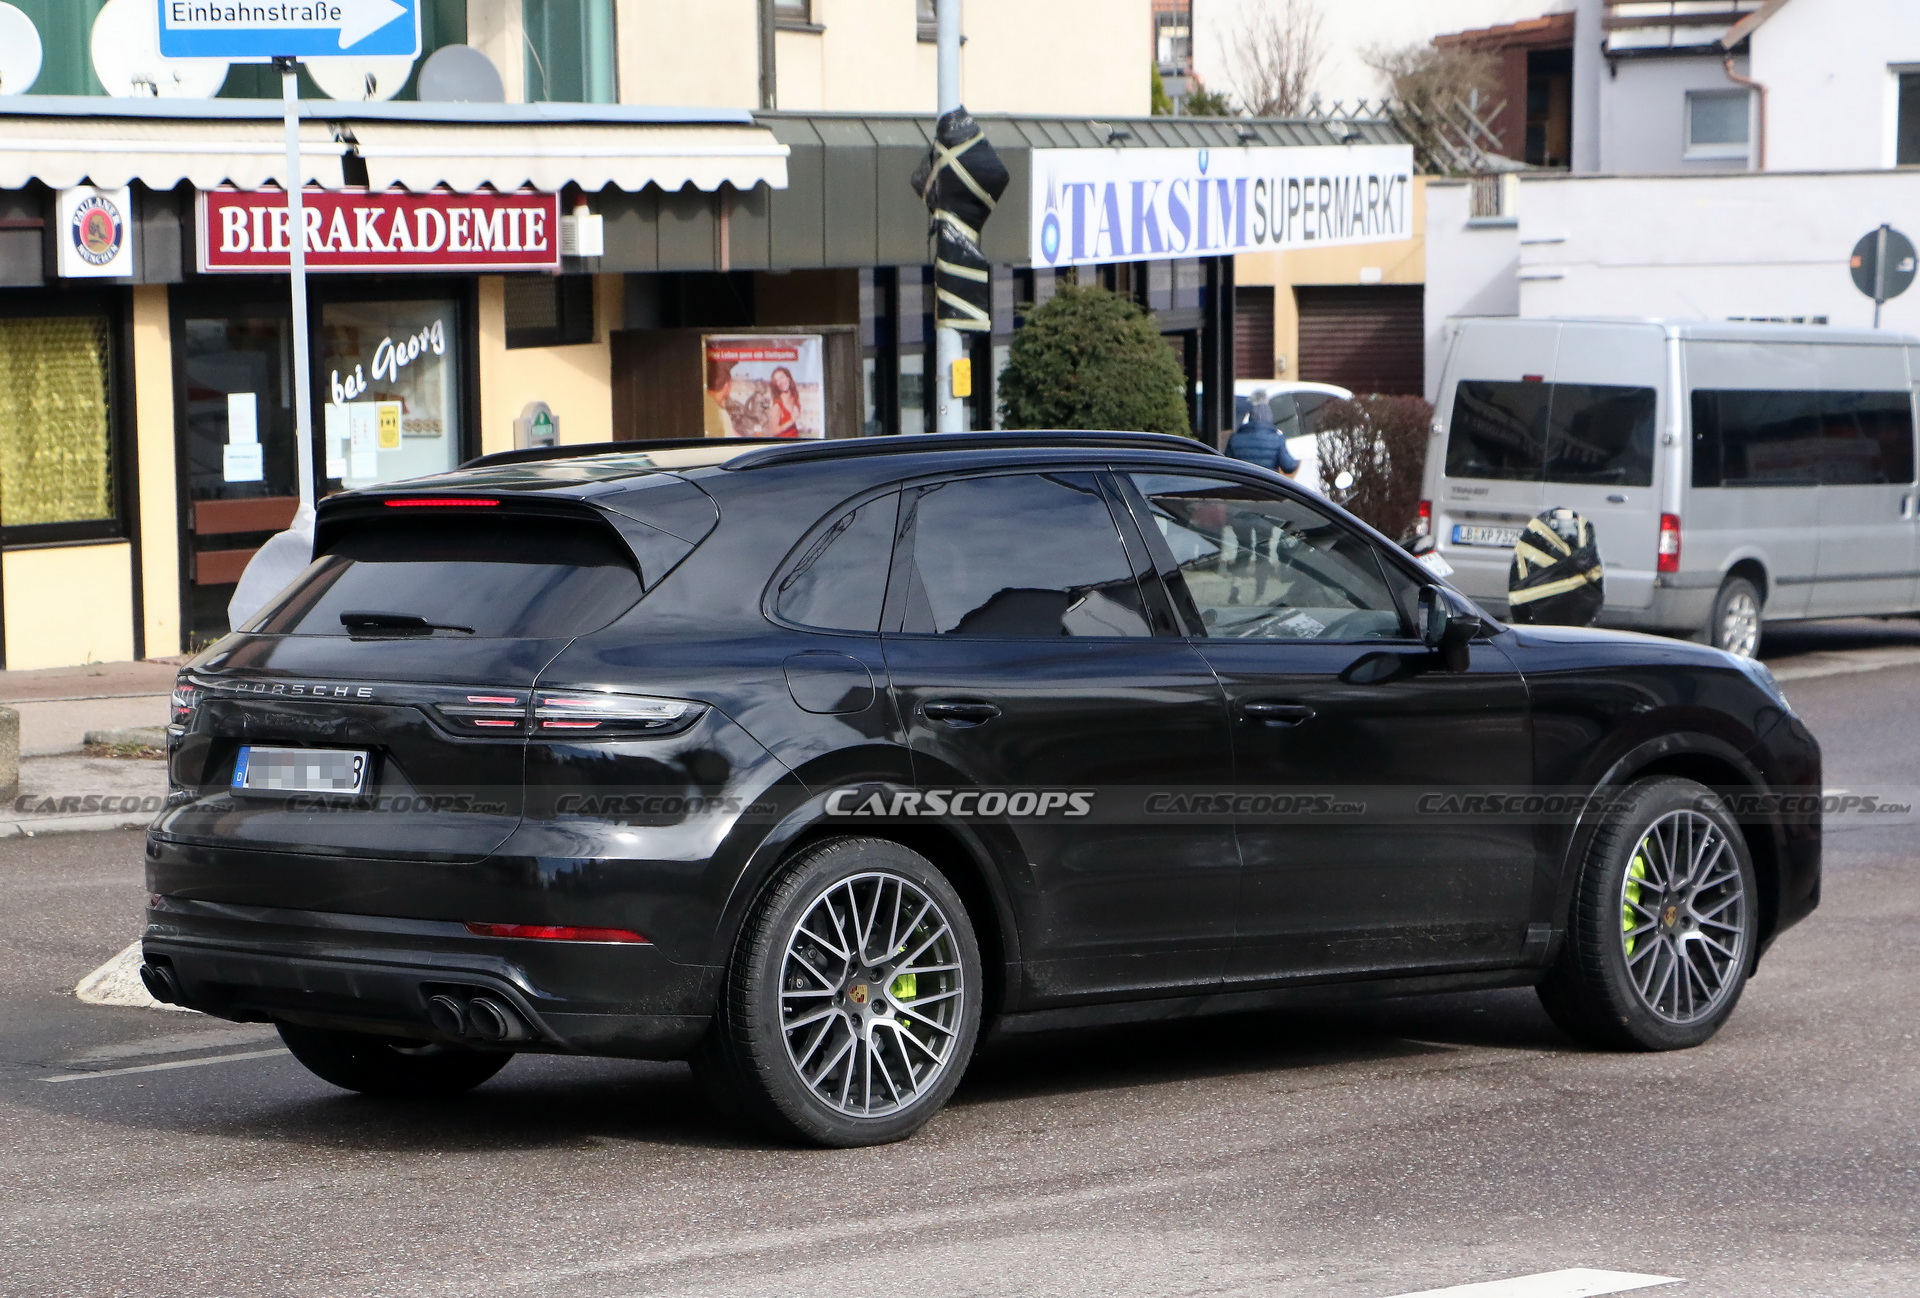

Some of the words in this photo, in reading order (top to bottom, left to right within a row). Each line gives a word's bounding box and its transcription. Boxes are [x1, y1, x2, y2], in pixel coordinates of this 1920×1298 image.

[172, 2, 342, 22] Einbahnstraße
[73, 197, 121, 227] PAULANER
[1252, 174, 1408, 245] SUPERMARKT
[219, 206, 548, 253] BIERAKADEMIE
[331, 363, 368, 407] bei
[371, 318, 446, 383] Georg
[235, 683, 373, 698] PORSCHE
